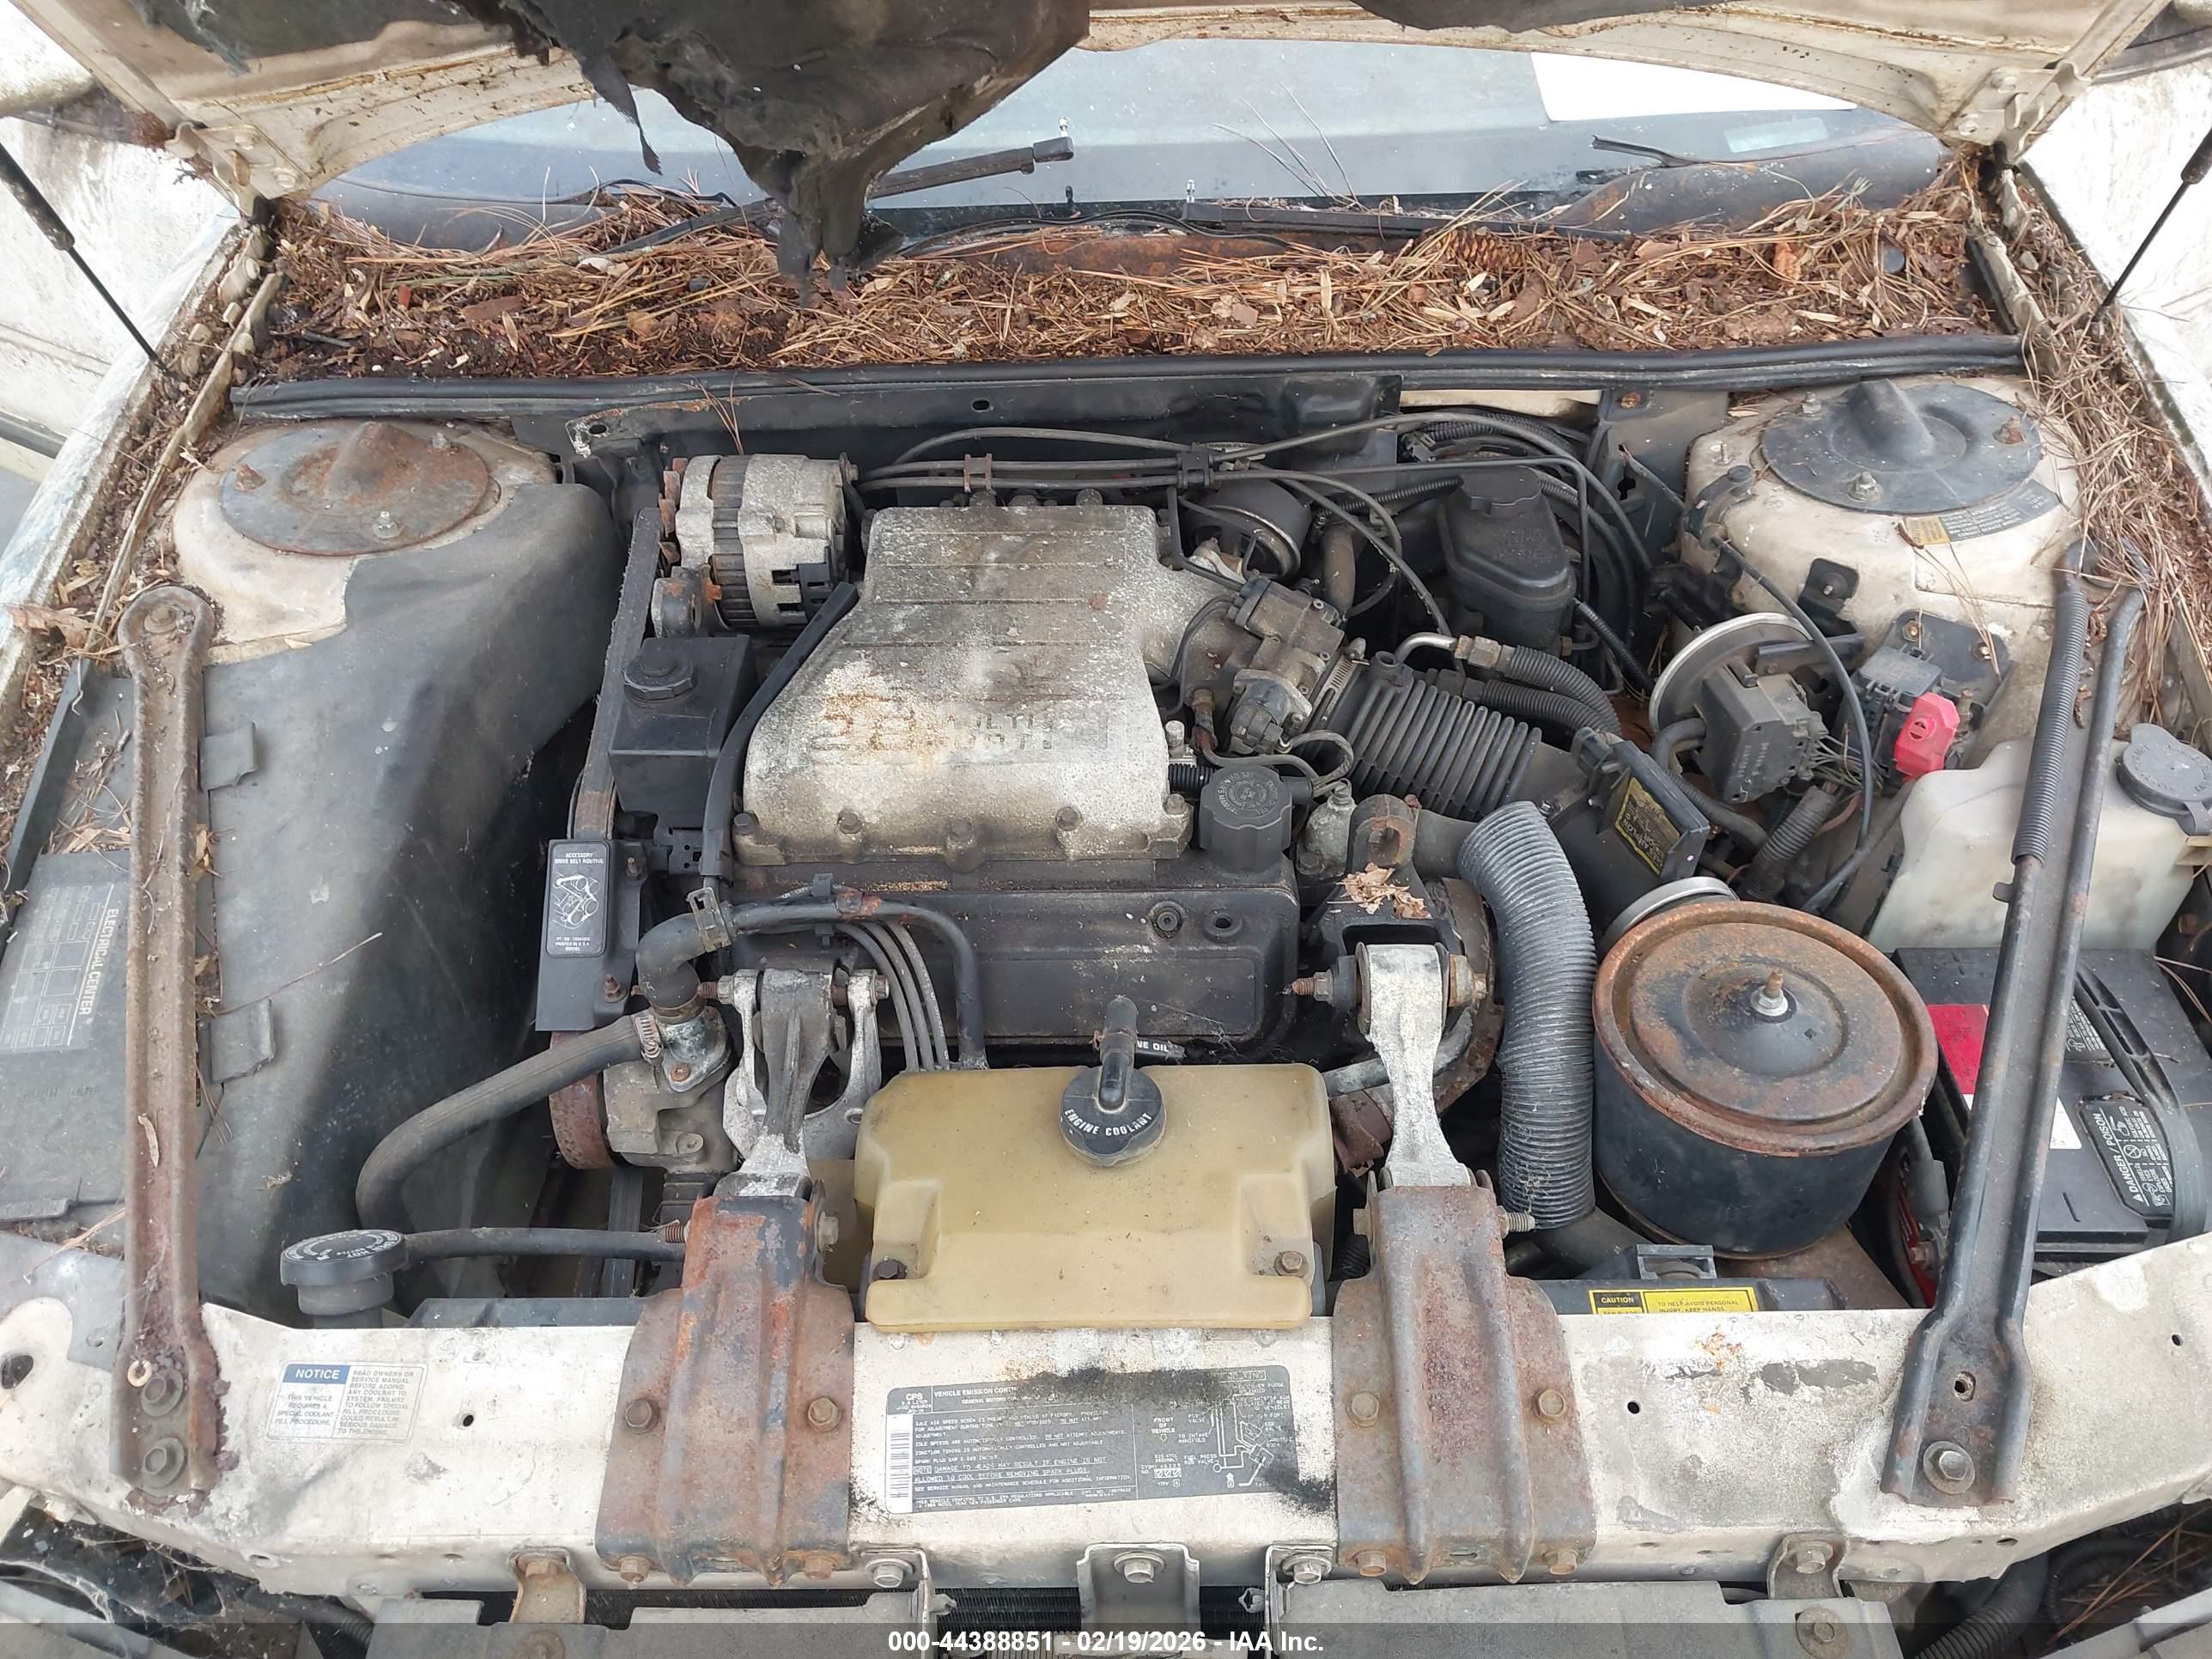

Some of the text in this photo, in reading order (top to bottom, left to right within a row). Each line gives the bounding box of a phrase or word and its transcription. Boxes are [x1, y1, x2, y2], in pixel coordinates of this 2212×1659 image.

[79, 908, 119, 1016] ELECTRICAL CENTER
[1152, 1042, 1170, 1052] OIL
[1064, 1109, 1153, 1137] ENGINE COOLANT
[2092, 1113, 2140, 1193] DANGER POISON
[295, 1369, 340, 1380] NOTICE
[962, 1388, 993, 1396] EMISSION
